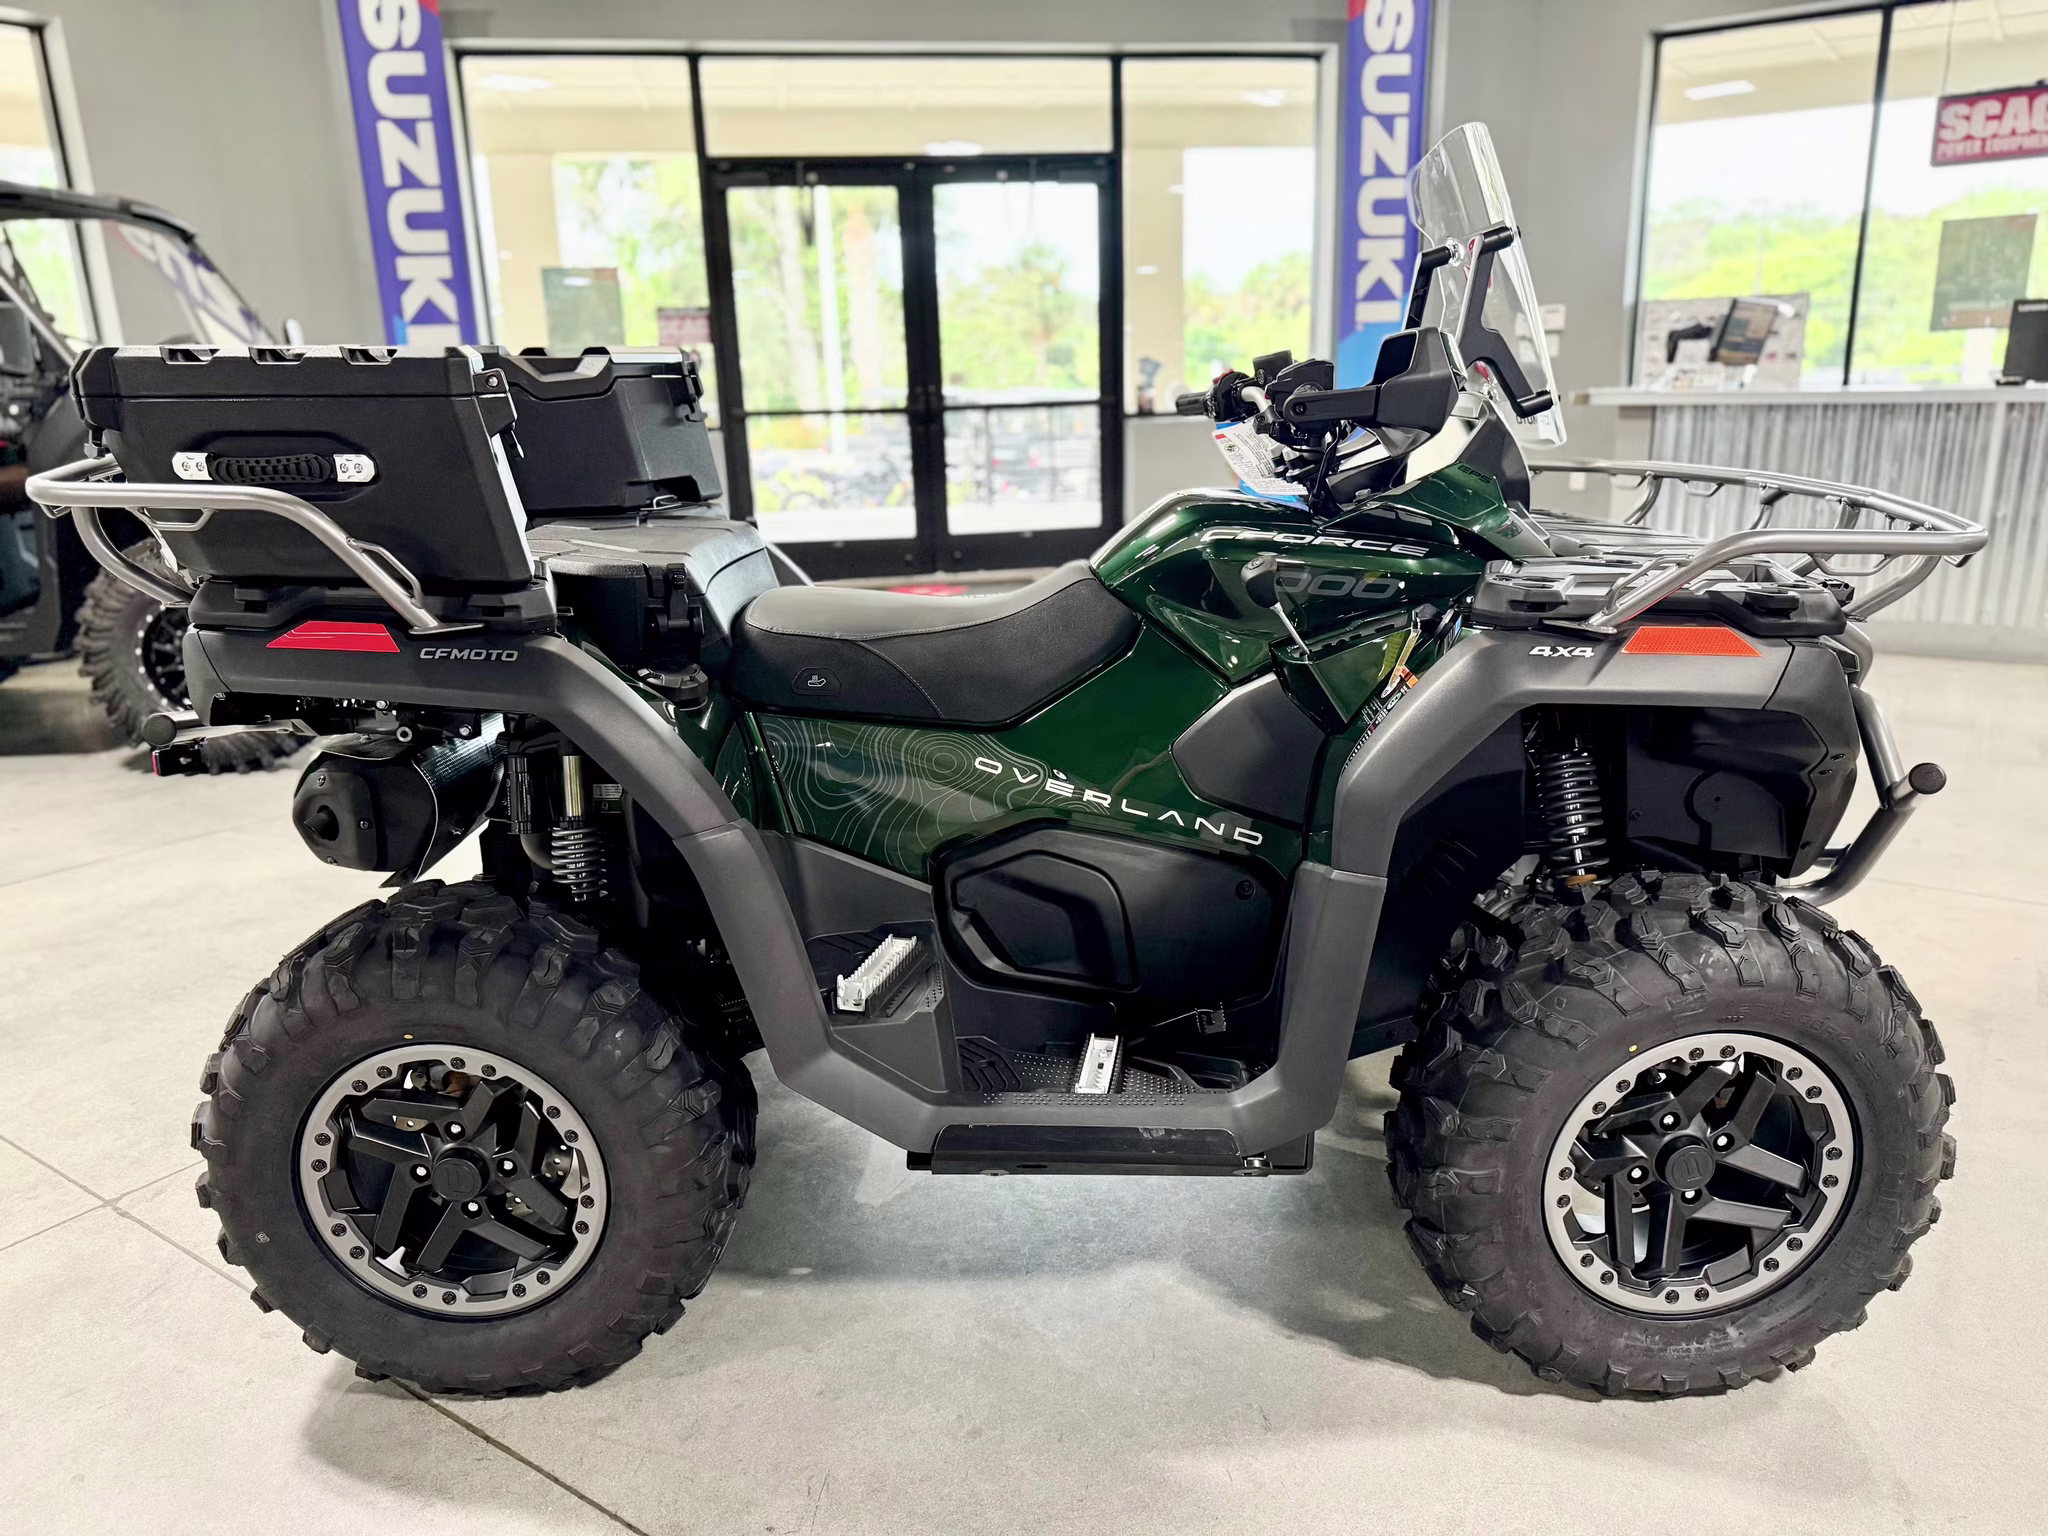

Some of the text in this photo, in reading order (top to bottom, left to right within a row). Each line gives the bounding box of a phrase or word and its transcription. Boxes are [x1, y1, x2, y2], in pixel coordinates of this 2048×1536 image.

[359, 0, 462, 346] SUZUKI
[1355, 0, 1415, 323] SUZUKI
[1458, 464, 1492, 484] EPS
[1200, 528, 1430, 558] CFORCE
[1274, 570, 1401, 599] 000
[419, 647, 519, 662] CFMOTO
[974, 756, 1263, 846] OVERLAND
